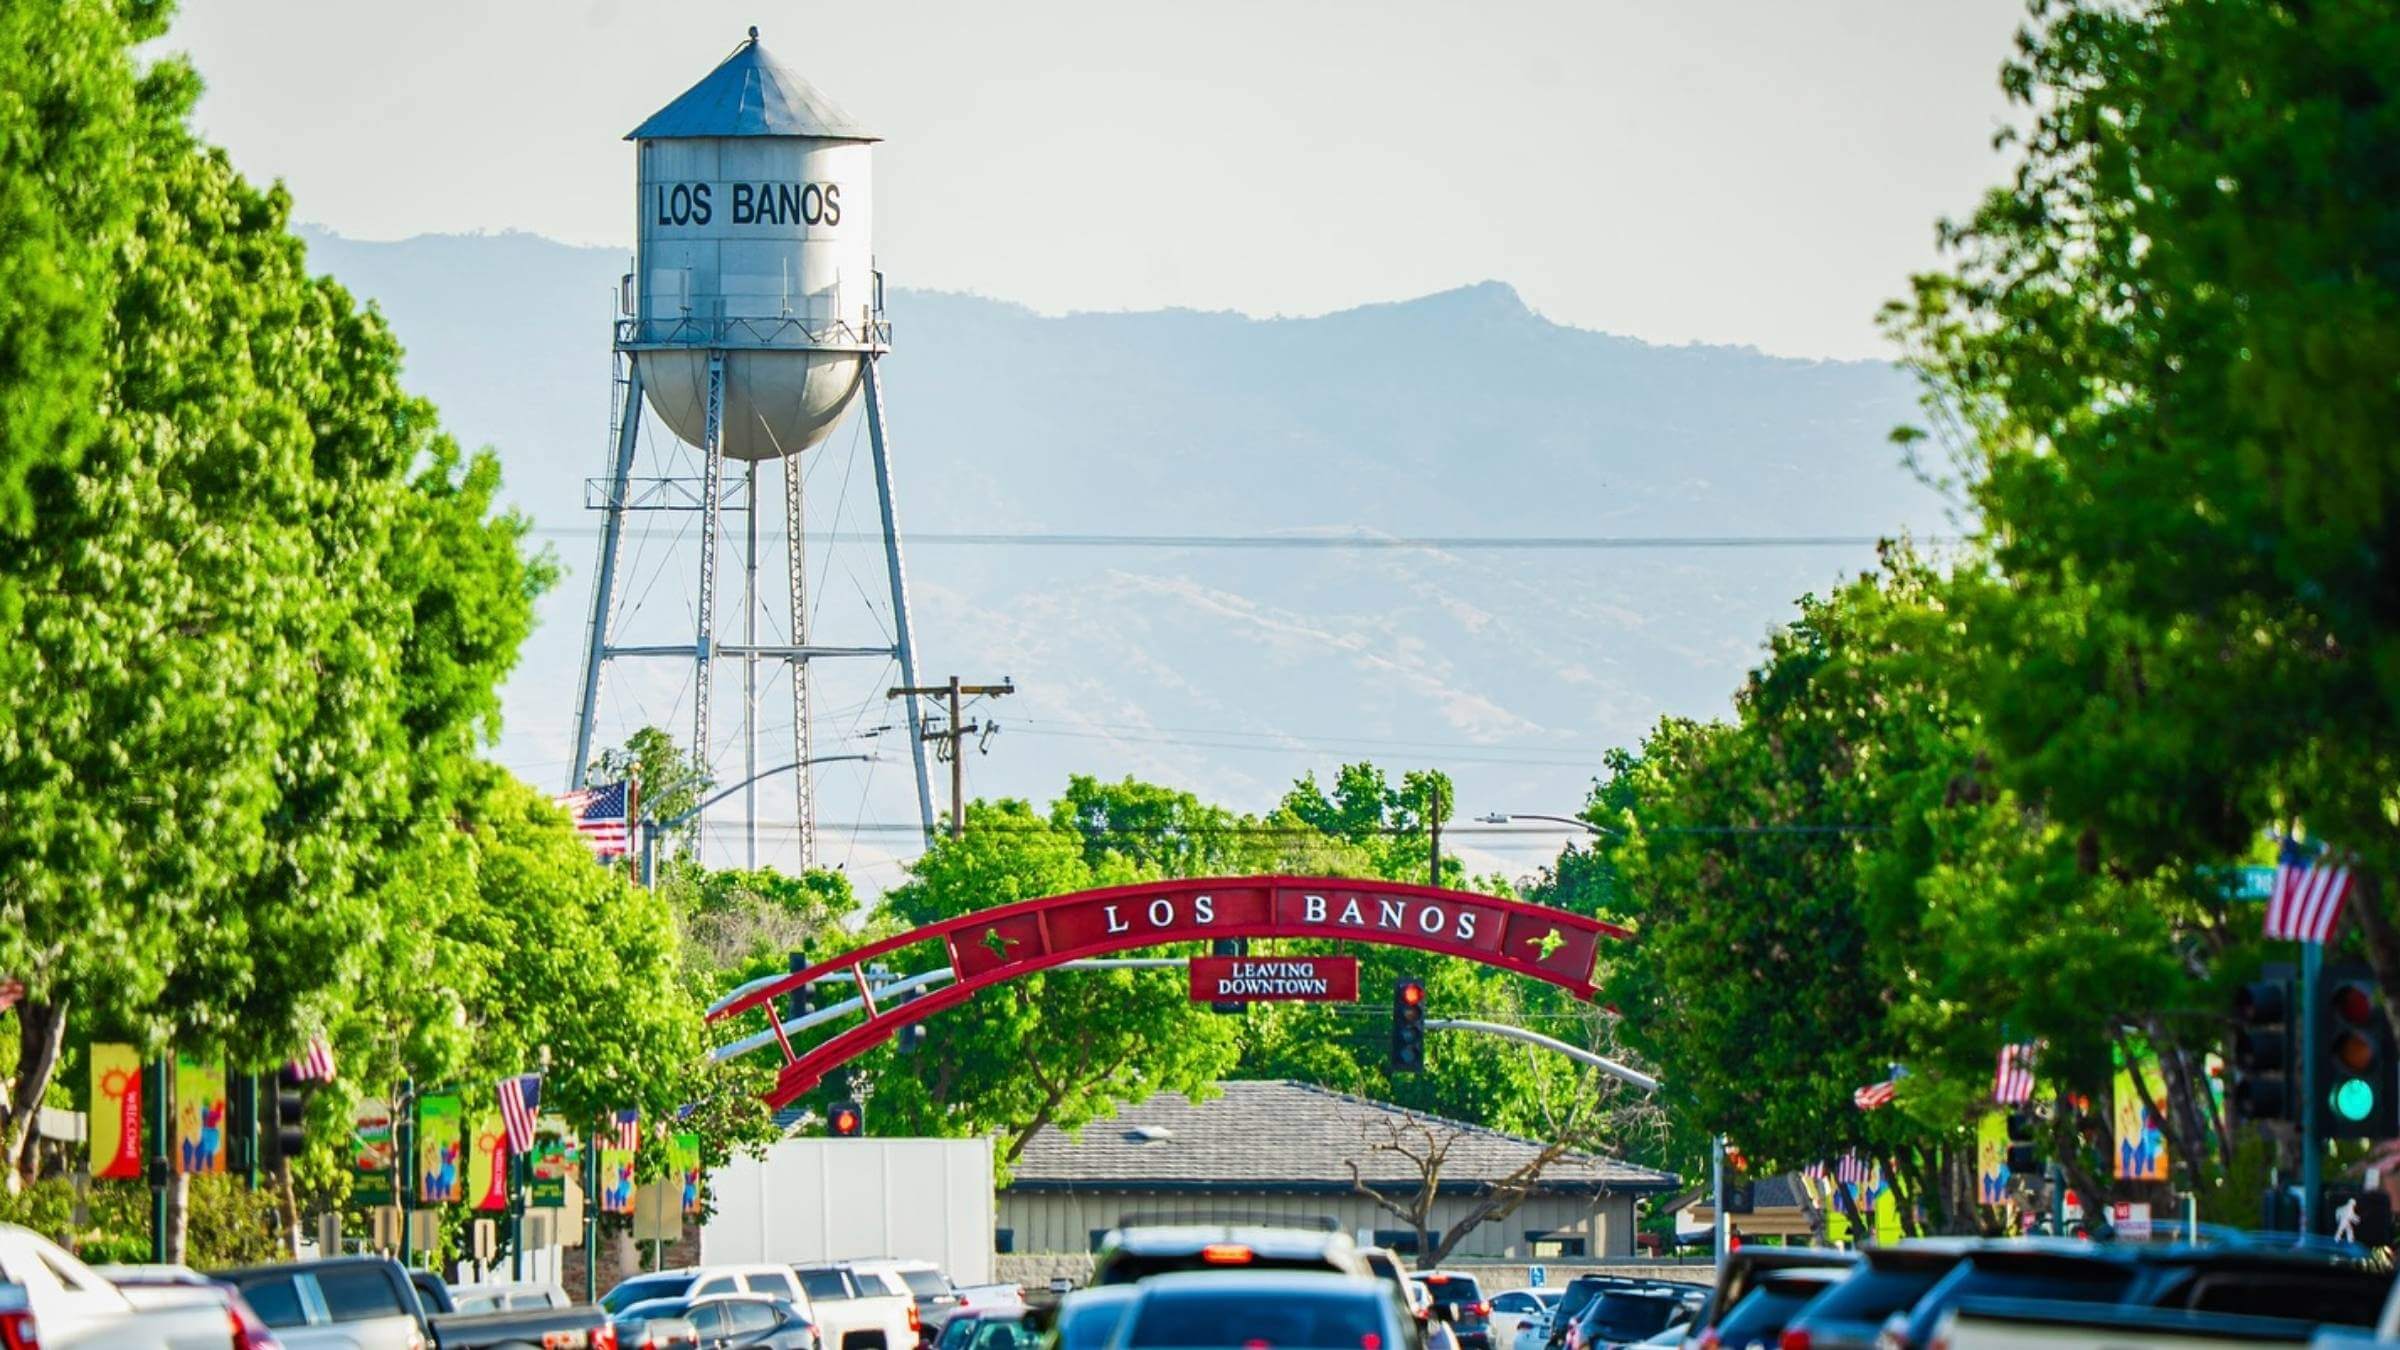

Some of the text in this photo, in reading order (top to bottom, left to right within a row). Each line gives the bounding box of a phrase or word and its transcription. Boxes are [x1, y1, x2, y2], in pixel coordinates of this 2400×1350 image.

[658, 182, 841, 226] LOS BANOS
[1105, 895, 1477, 940] LOS BANOS
[1217, 978, 1328, 995] DOWNTOWN
[1231, 962, 1315, 978] LEAVING
[125, 1091, 138, 1159] WELCOME
